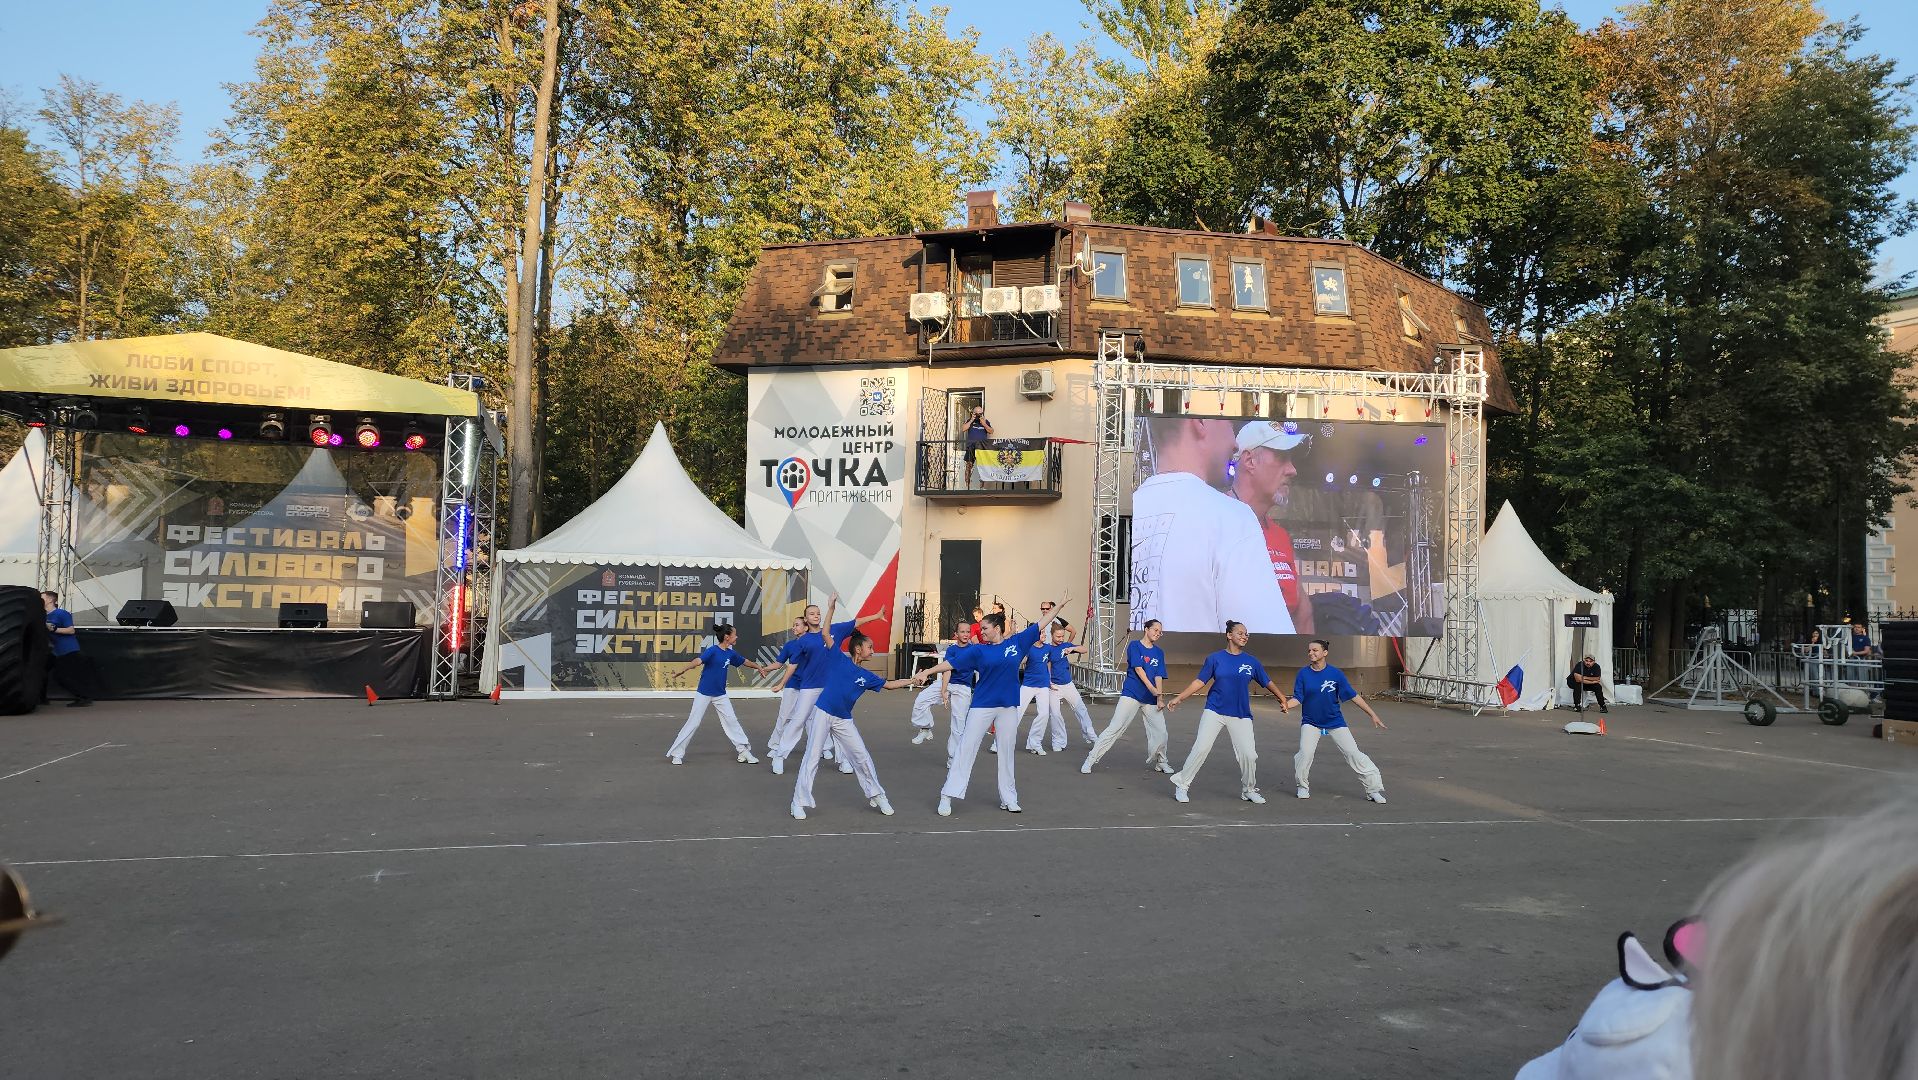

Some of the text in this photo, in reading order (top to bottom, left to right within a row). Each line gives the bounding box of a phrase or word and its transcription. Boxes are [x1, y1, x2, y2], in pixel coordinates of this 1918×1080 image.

[126, 353, 278, 378] ЛЮБИ СПОРТ,
[89, 374, 311, 400] ЖИВИ ЗДОРОВЬЕМ!
[774, 421, 894, 439] МОЛОДЕЖНЫЙ
[842, 441, 894, 455] ЦЕНТР
[166, 524, 386, 550] ФЕСТИВАЛЬ
[163, 550, 385, 581] СИЛОВОГО
[577, 589, 735, 607] ФЕСТИВАЛЬ
[576, 609, 734, 630] СИЛОВОГО
[575, 633, 719, 654] ЭКСТРИМ
